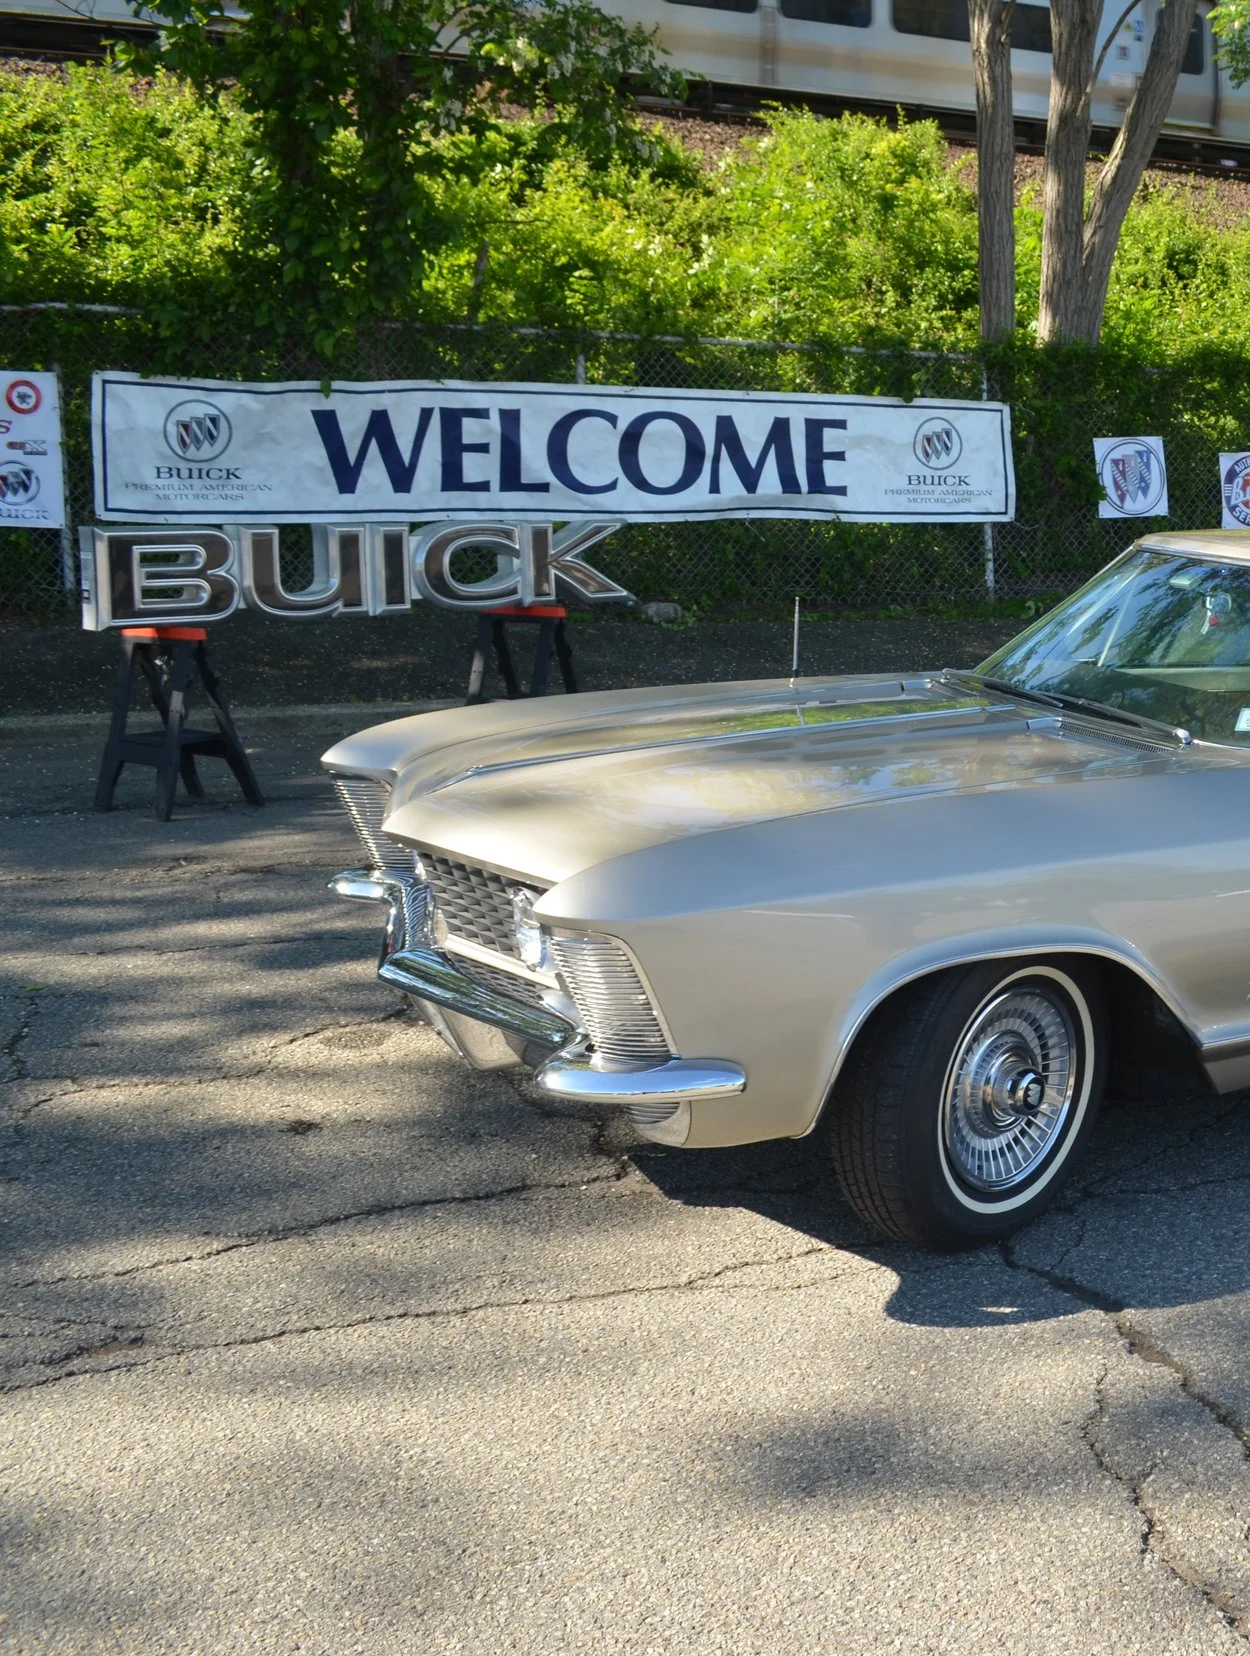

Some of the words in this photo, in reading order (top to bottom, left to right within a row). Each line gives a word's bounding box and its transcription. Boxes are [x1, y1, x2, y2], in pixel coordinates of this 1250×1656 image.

[311, 405, 848, 498] WELCOME
[154, 465, 243, 481] BUICK
[124, 482, 194, 491] PREMIUM
[200, 483, 273, 492] AMERICAN
[906, 474, 971, 487] BUICK
[155, 493, 244, 501] MOTORCARS
[884, 488, 935, 496] PREMIUM
[939, 489, 993, 497] AMERICAN
[906, 496, 972, 504] MOTORCARS
[0, 507, 49, 520] UICK
[79, 518, 637, 632] BUICK
